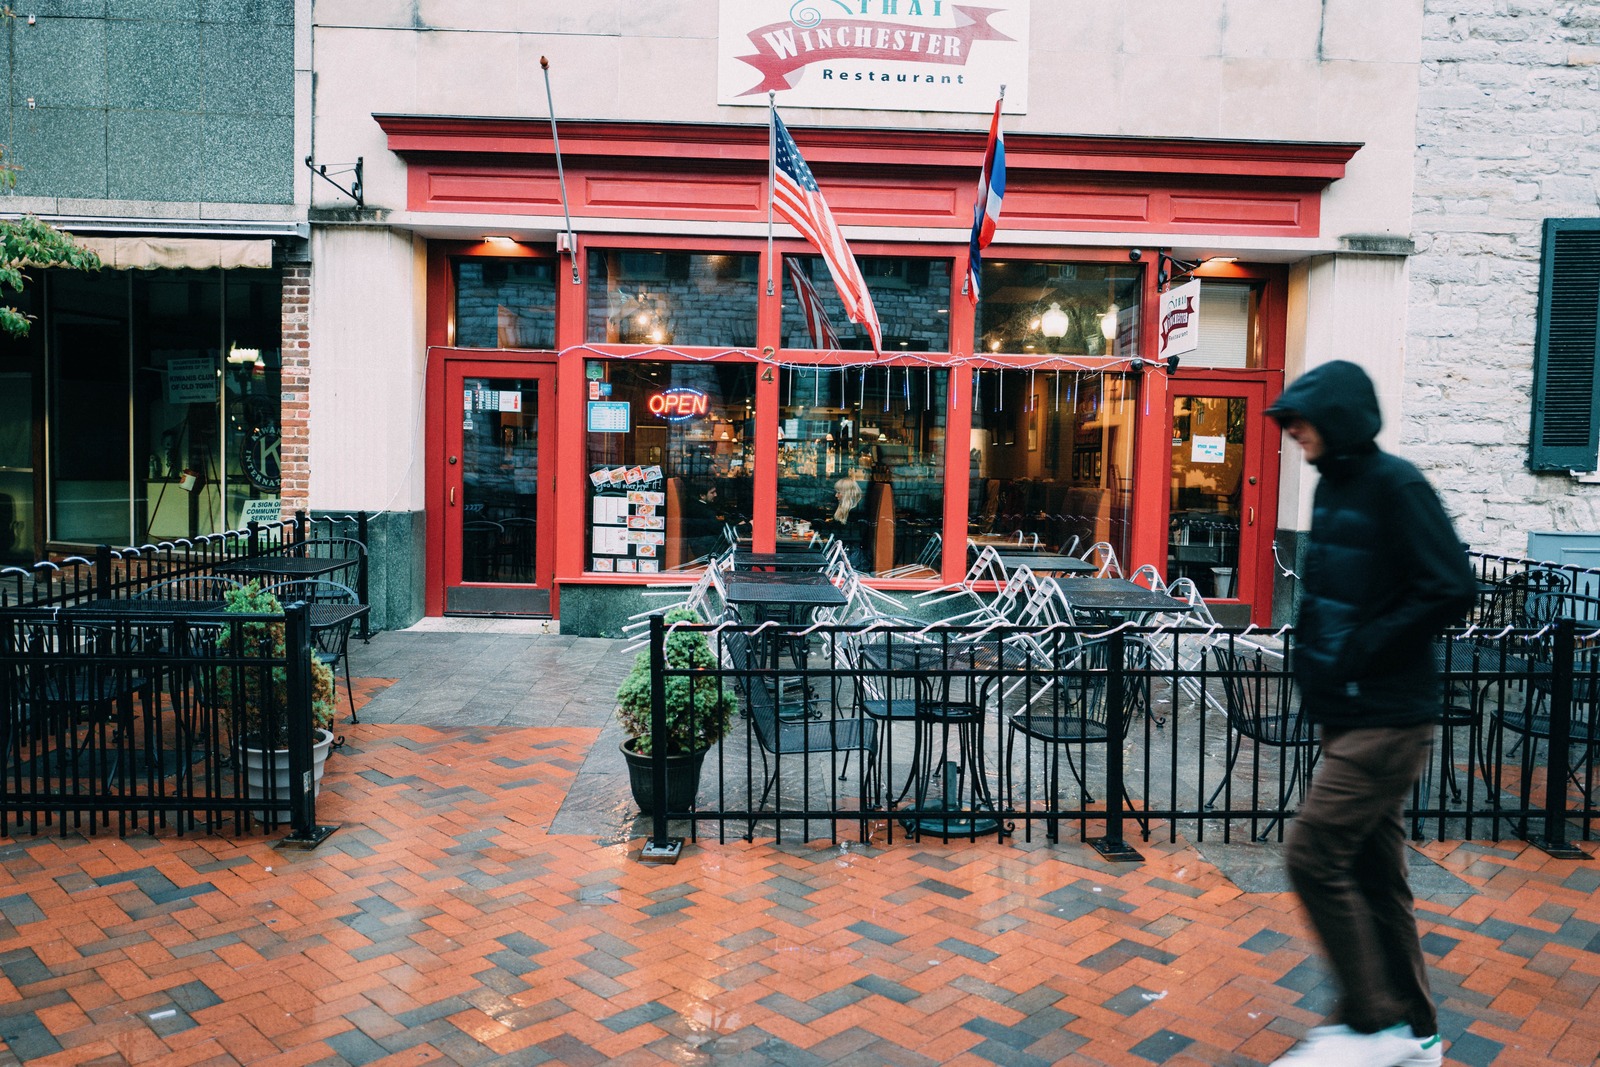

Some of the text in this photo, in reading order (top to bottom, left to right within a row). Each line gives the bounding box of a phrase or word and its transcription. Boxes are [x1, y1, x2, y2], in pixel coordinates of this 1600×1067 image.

[860, 0, 942, 16] THAI
[761, 26, 961, 60] WINCHESTER
[823, 68, 965, 85] Restaurant
[170, 373, 215, 382] KIWANIS CLUB
[648, 394, 709, 414] OPEN
